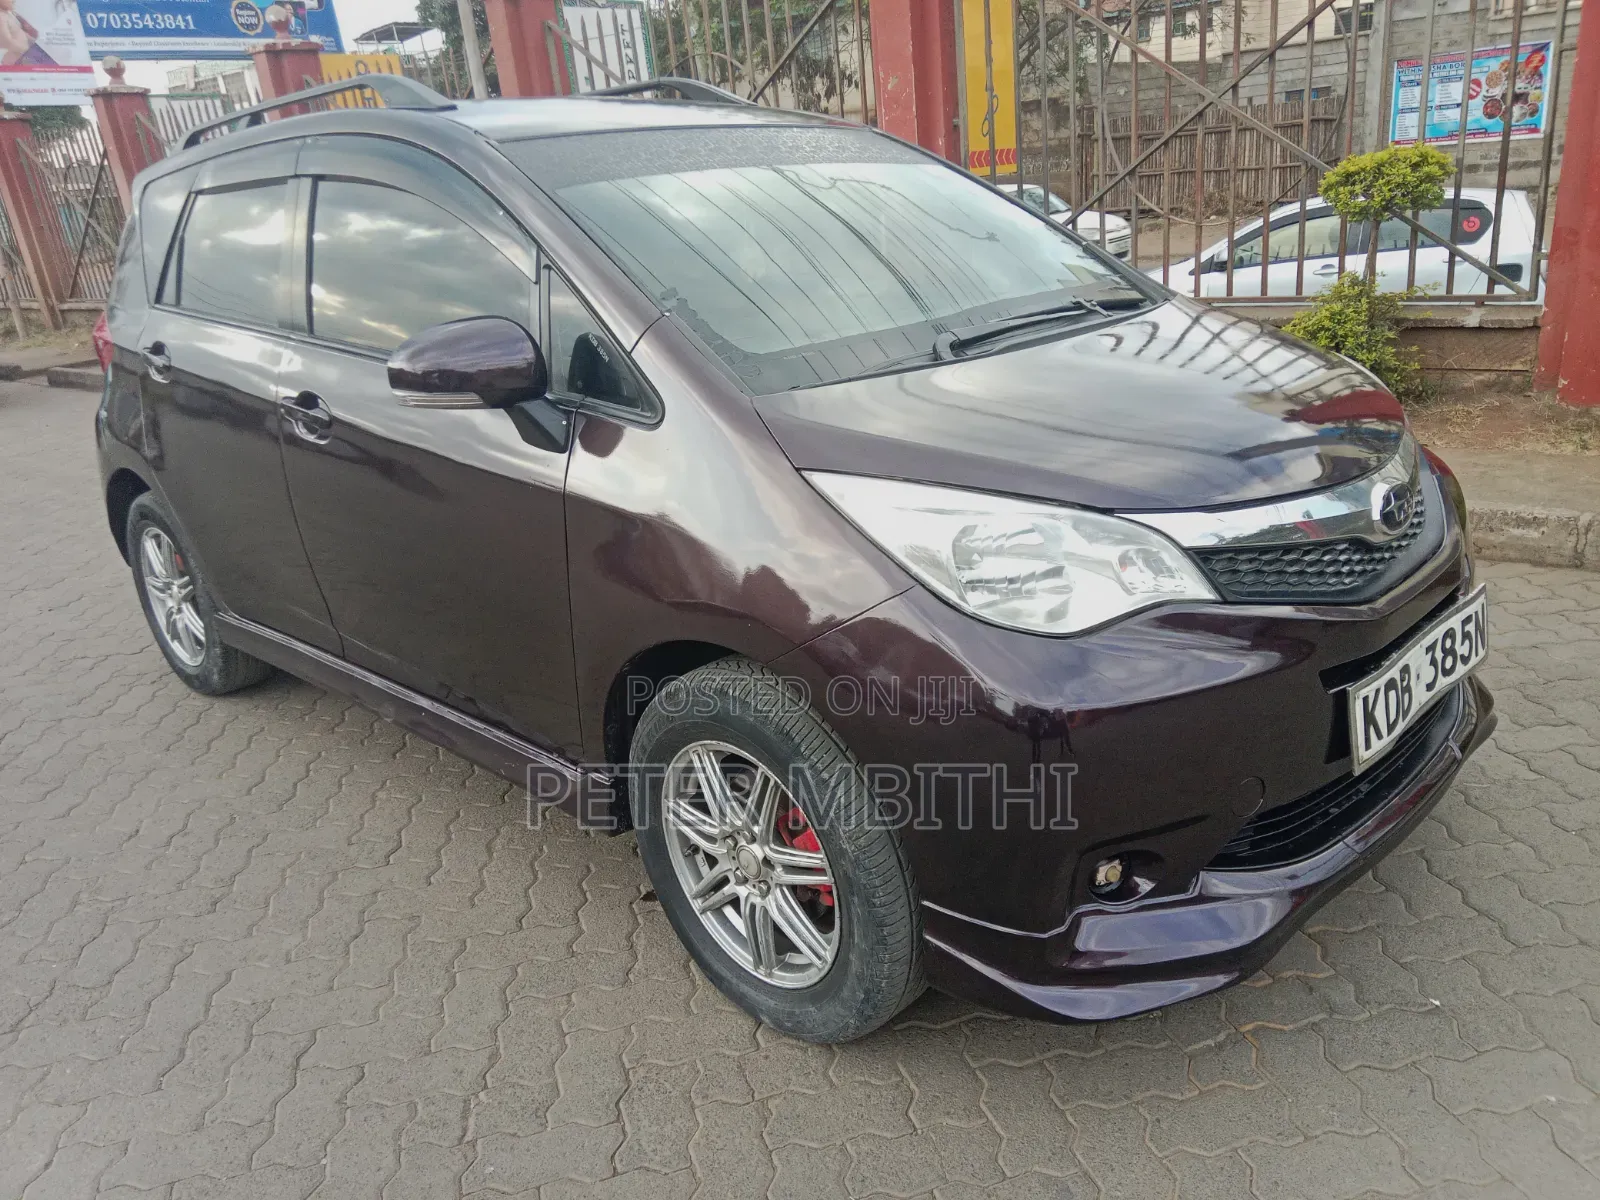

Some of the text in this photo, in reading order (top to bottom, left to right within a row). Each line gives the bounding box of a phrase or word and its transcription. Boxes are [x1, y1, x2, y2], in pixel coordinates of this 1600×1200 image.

[86, 12, 197, 30] 0703543841
[237, 16, 258, 24] NOW
[1398, 67, 1416, 75] WITH
[589, 333, 609, 362] KDB 385N
[1362, 602, 1486, 752] KDB 385N
